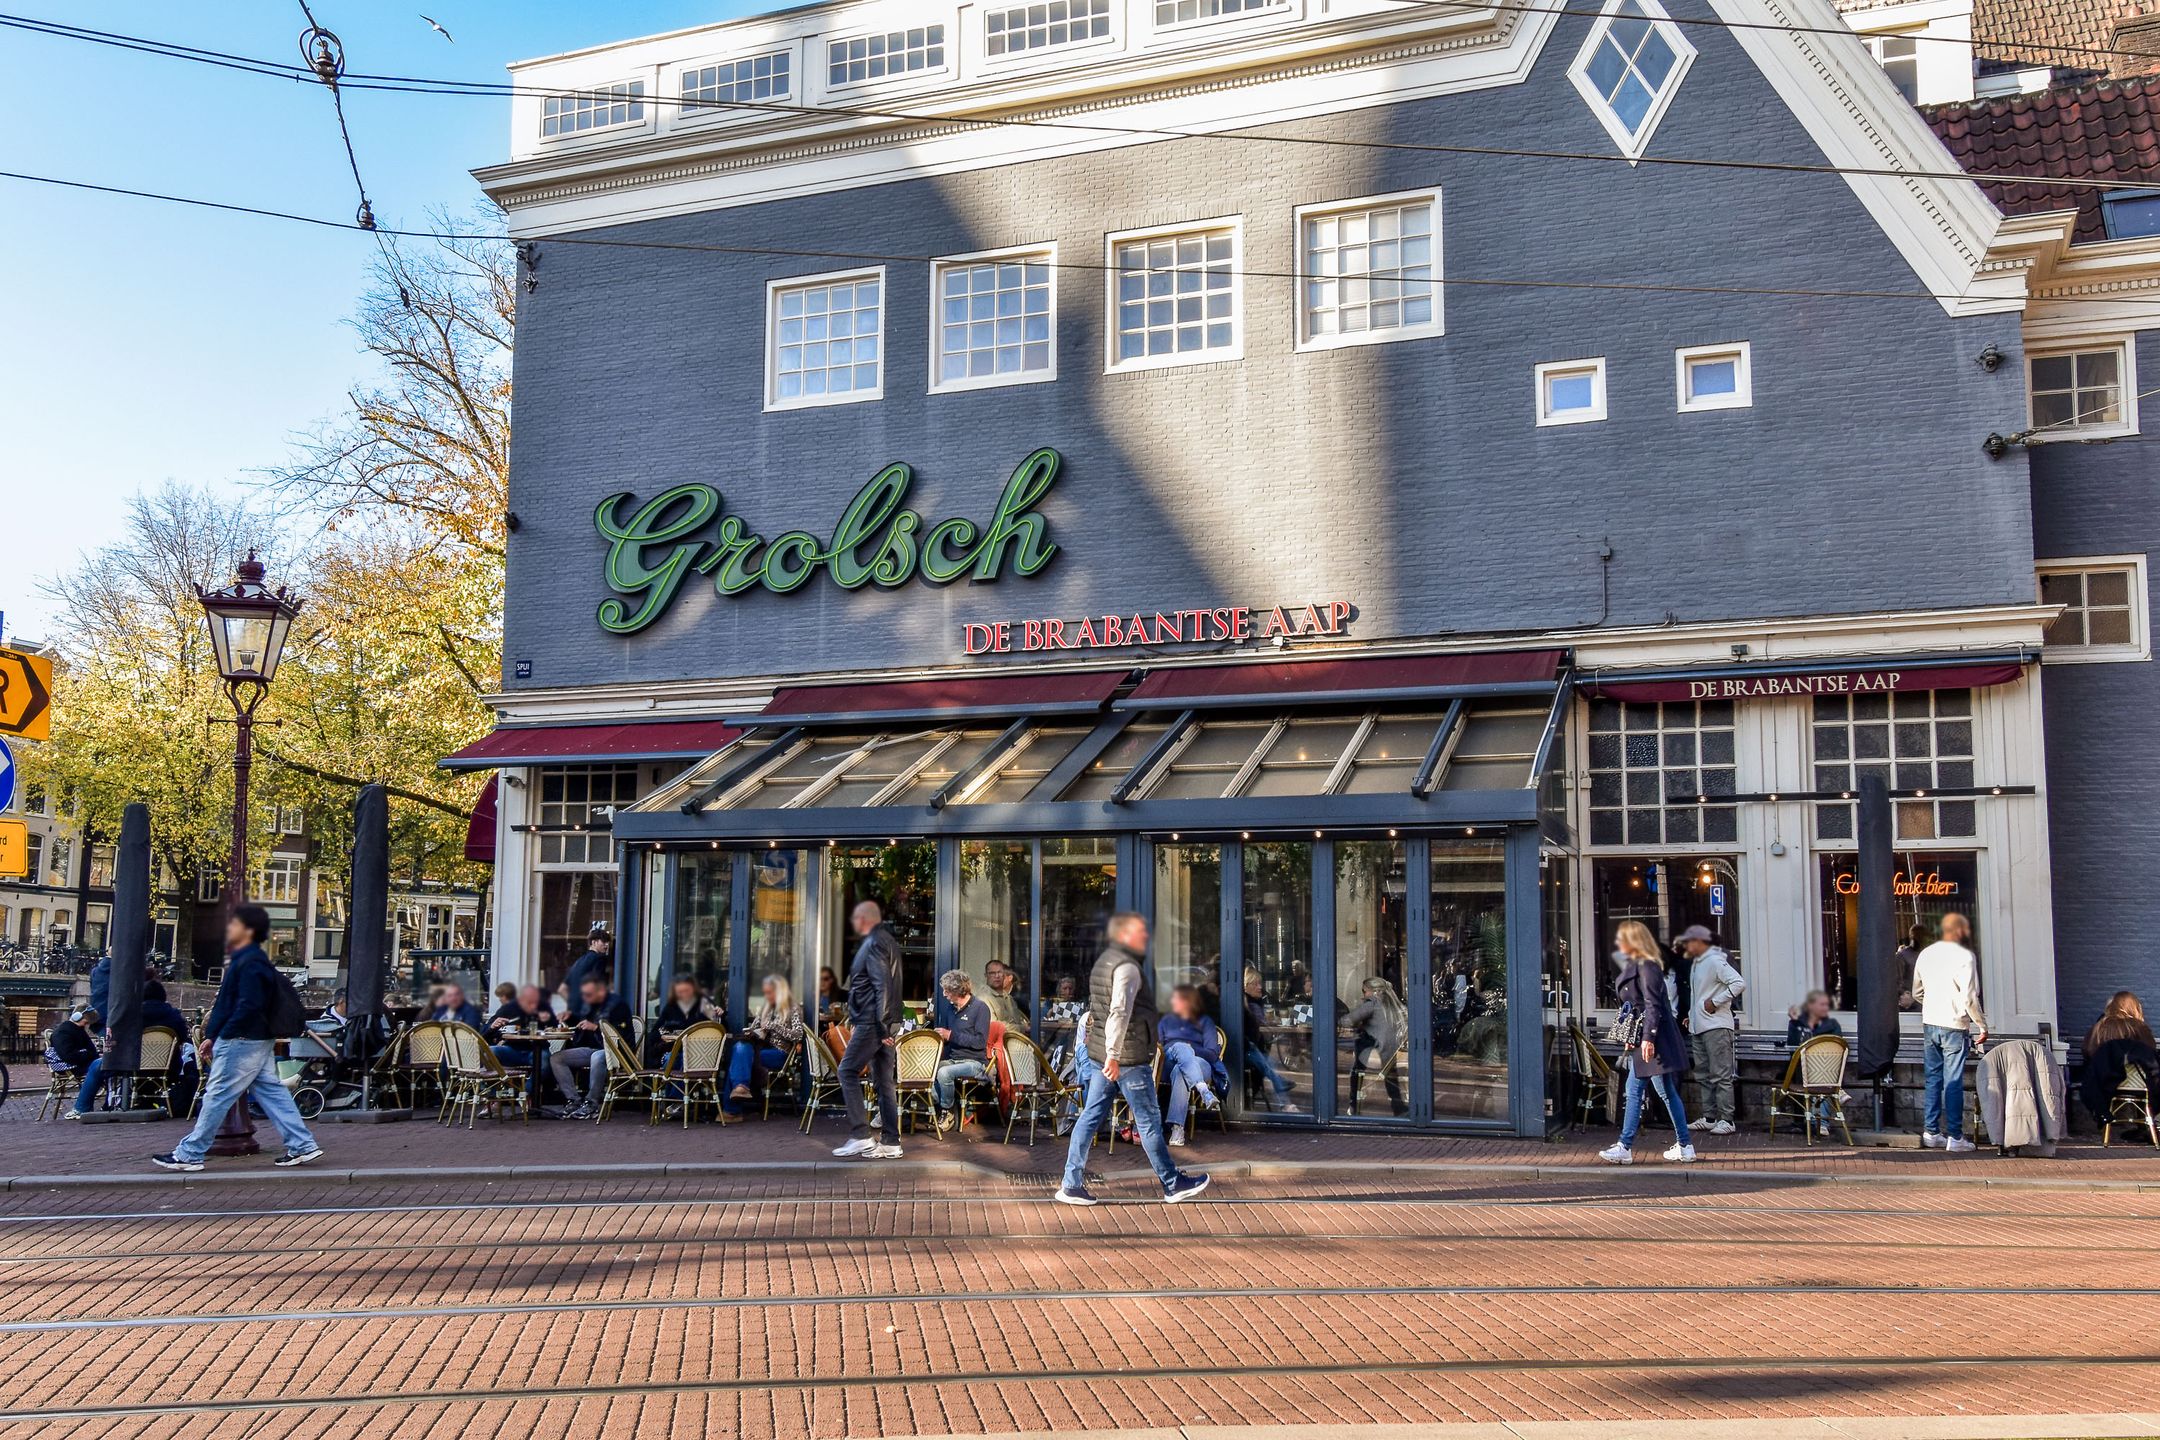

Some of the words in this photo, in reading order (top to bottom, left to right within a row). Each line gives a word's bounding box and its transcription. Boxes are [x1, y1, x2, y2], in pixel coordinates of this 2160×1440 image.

[594, 446, 1060, 634] Grolsch
[963, 621, 1012, 655] DE
[1021, 606, 1250, 651] BRABANTSE
[1264, 600, 1351, 638] AAP
[1689, 681, 1718, 698] DE
[1722, 675, 1849, 697] BRABANTSE
[1853, 672, 1901, 691] AAP
[1926, 873, 1955, 895] bier
